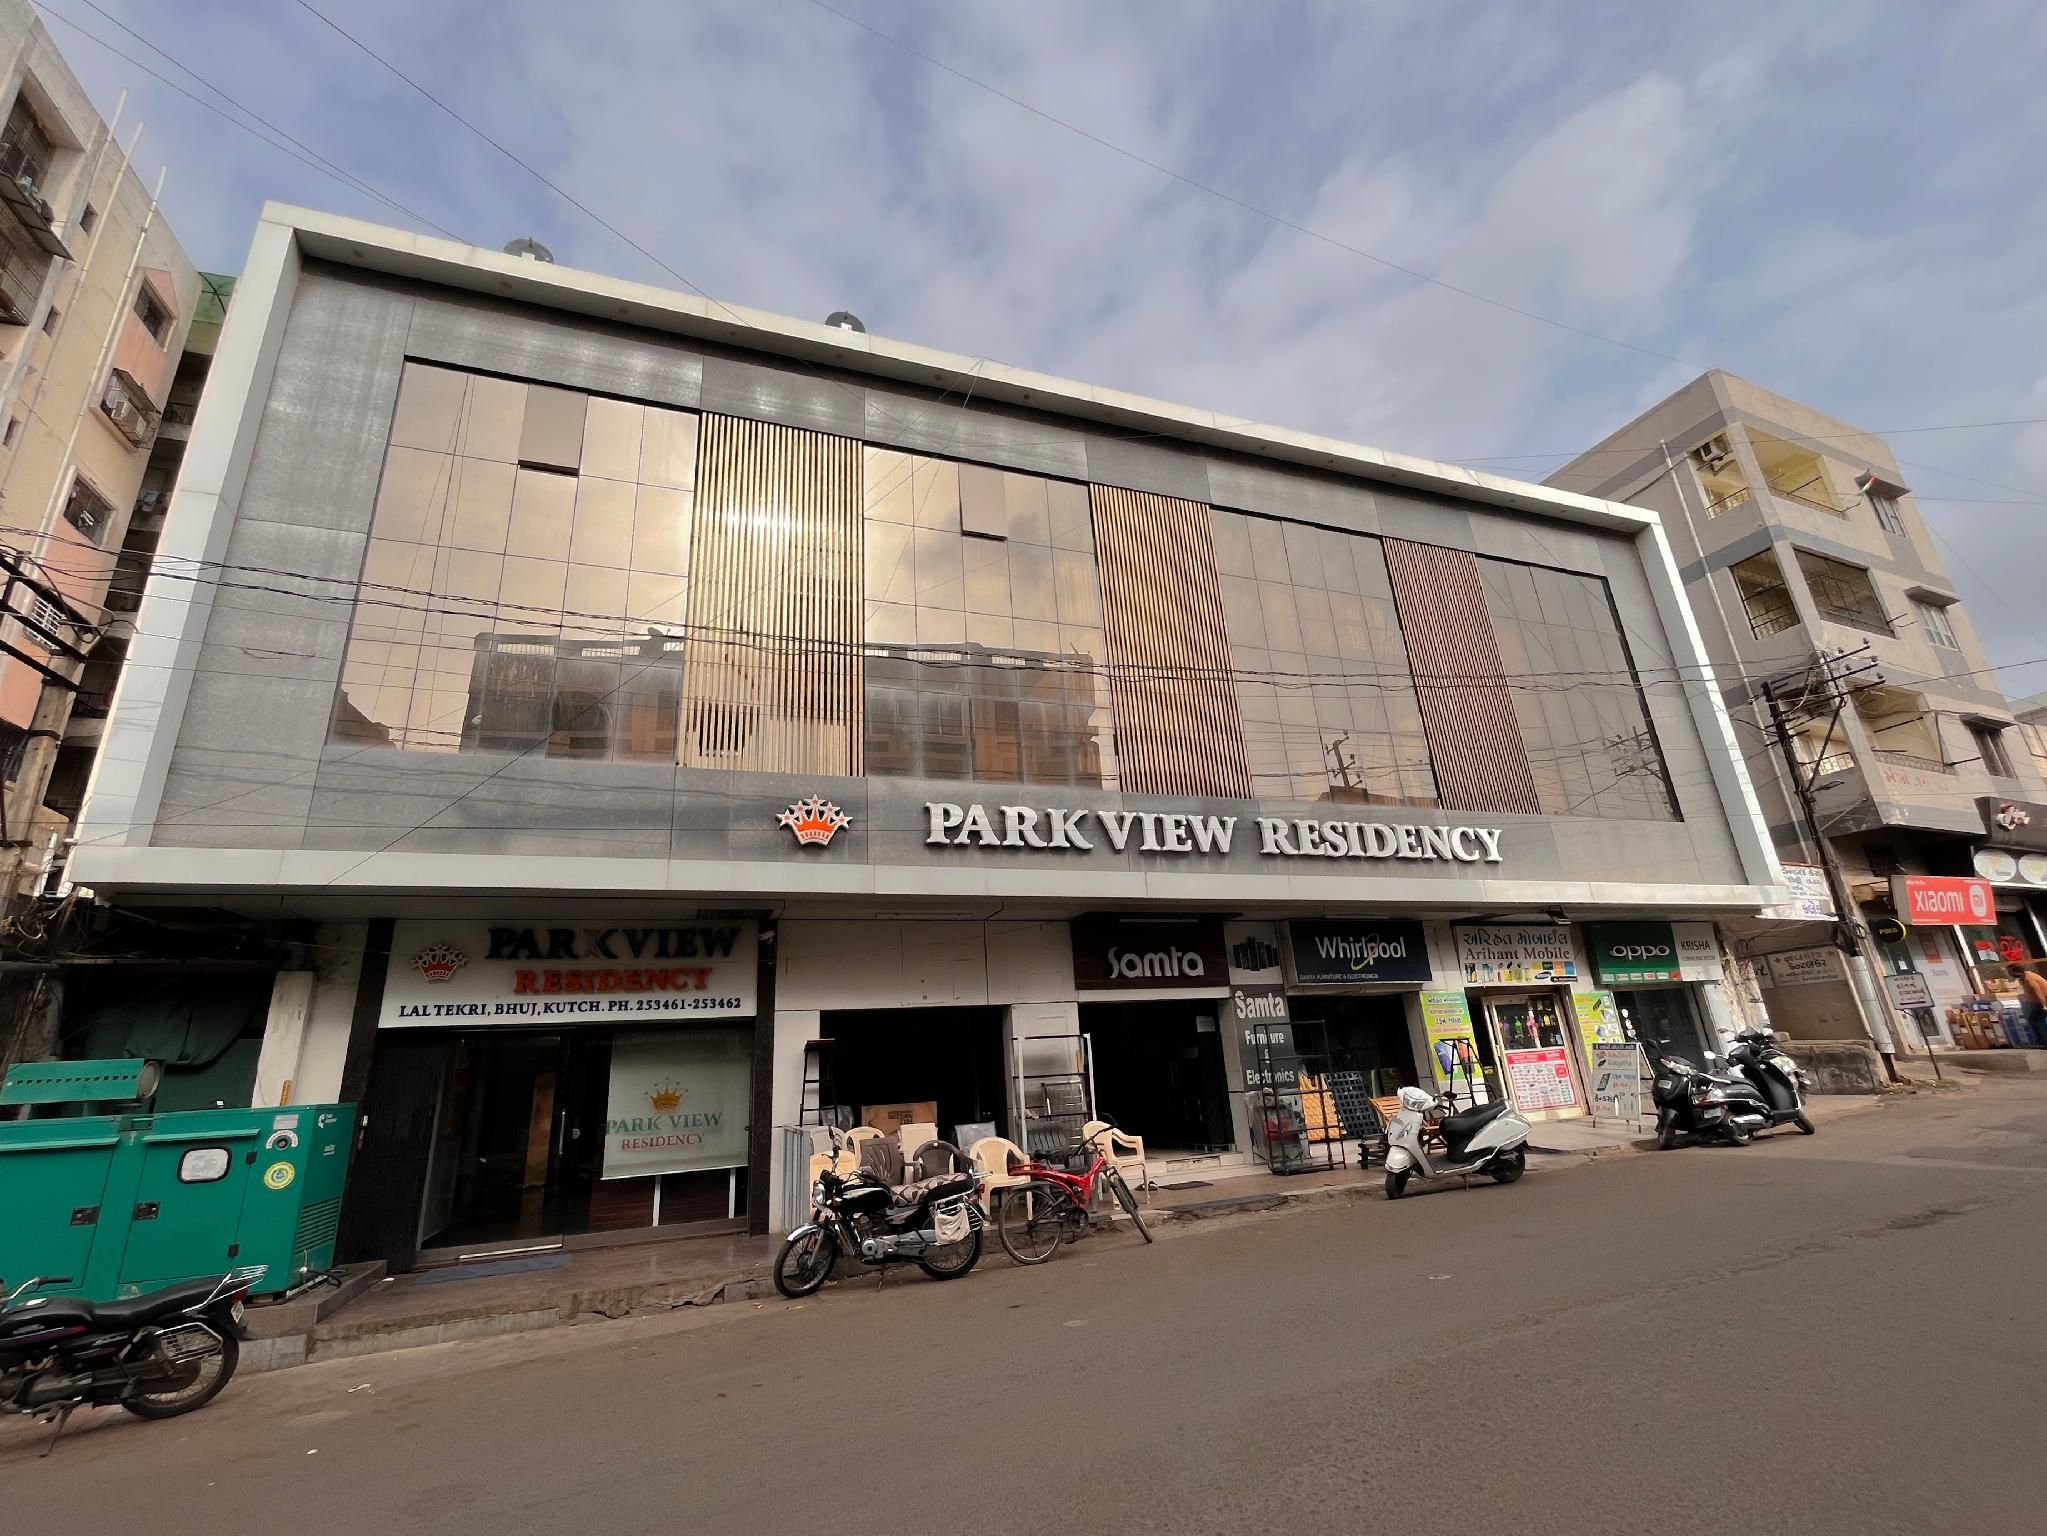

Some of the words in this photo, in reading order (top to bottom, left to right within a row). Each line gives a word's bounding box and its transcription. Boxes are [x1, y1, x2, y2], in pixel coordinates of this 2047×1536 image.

[1258, 819, 1504, 863] RESIDENCY
[1914, 890, 1964, 912] xiaomi
[1315, 936, 1406, 965] Whirlpool
[1465, 947, 1519, 960] Arihant
[1523, 946, 1569, 960] Mobile
[1610, 945, 1670, 960] oppo
[1680, 940, 1711, 951] KRISHA
[1108, 945, 1205, 979] Samta
[514, 968, 713, 994] RESIDENCY
[399, 1005, 431, 1017] LAL
[433, 1003, 491, 1016] TEKRI,
[494, 1002, 541, 1016] BHUJ,
[542, 1001, 604, 1014] KUTCH.
[607, 999, 633, 1012] PH.
[636, 997, 741, 1010] 253461-253462
[1235, 991, 1285, 1018] Samta
[1245, 1030, 1285, 1045] Furniure
[606, 1115, 662, 1134] PARK
[669, 1112, 723, 1129] VIEW
[622, 1133, 705, 1150] RESIDENCY
